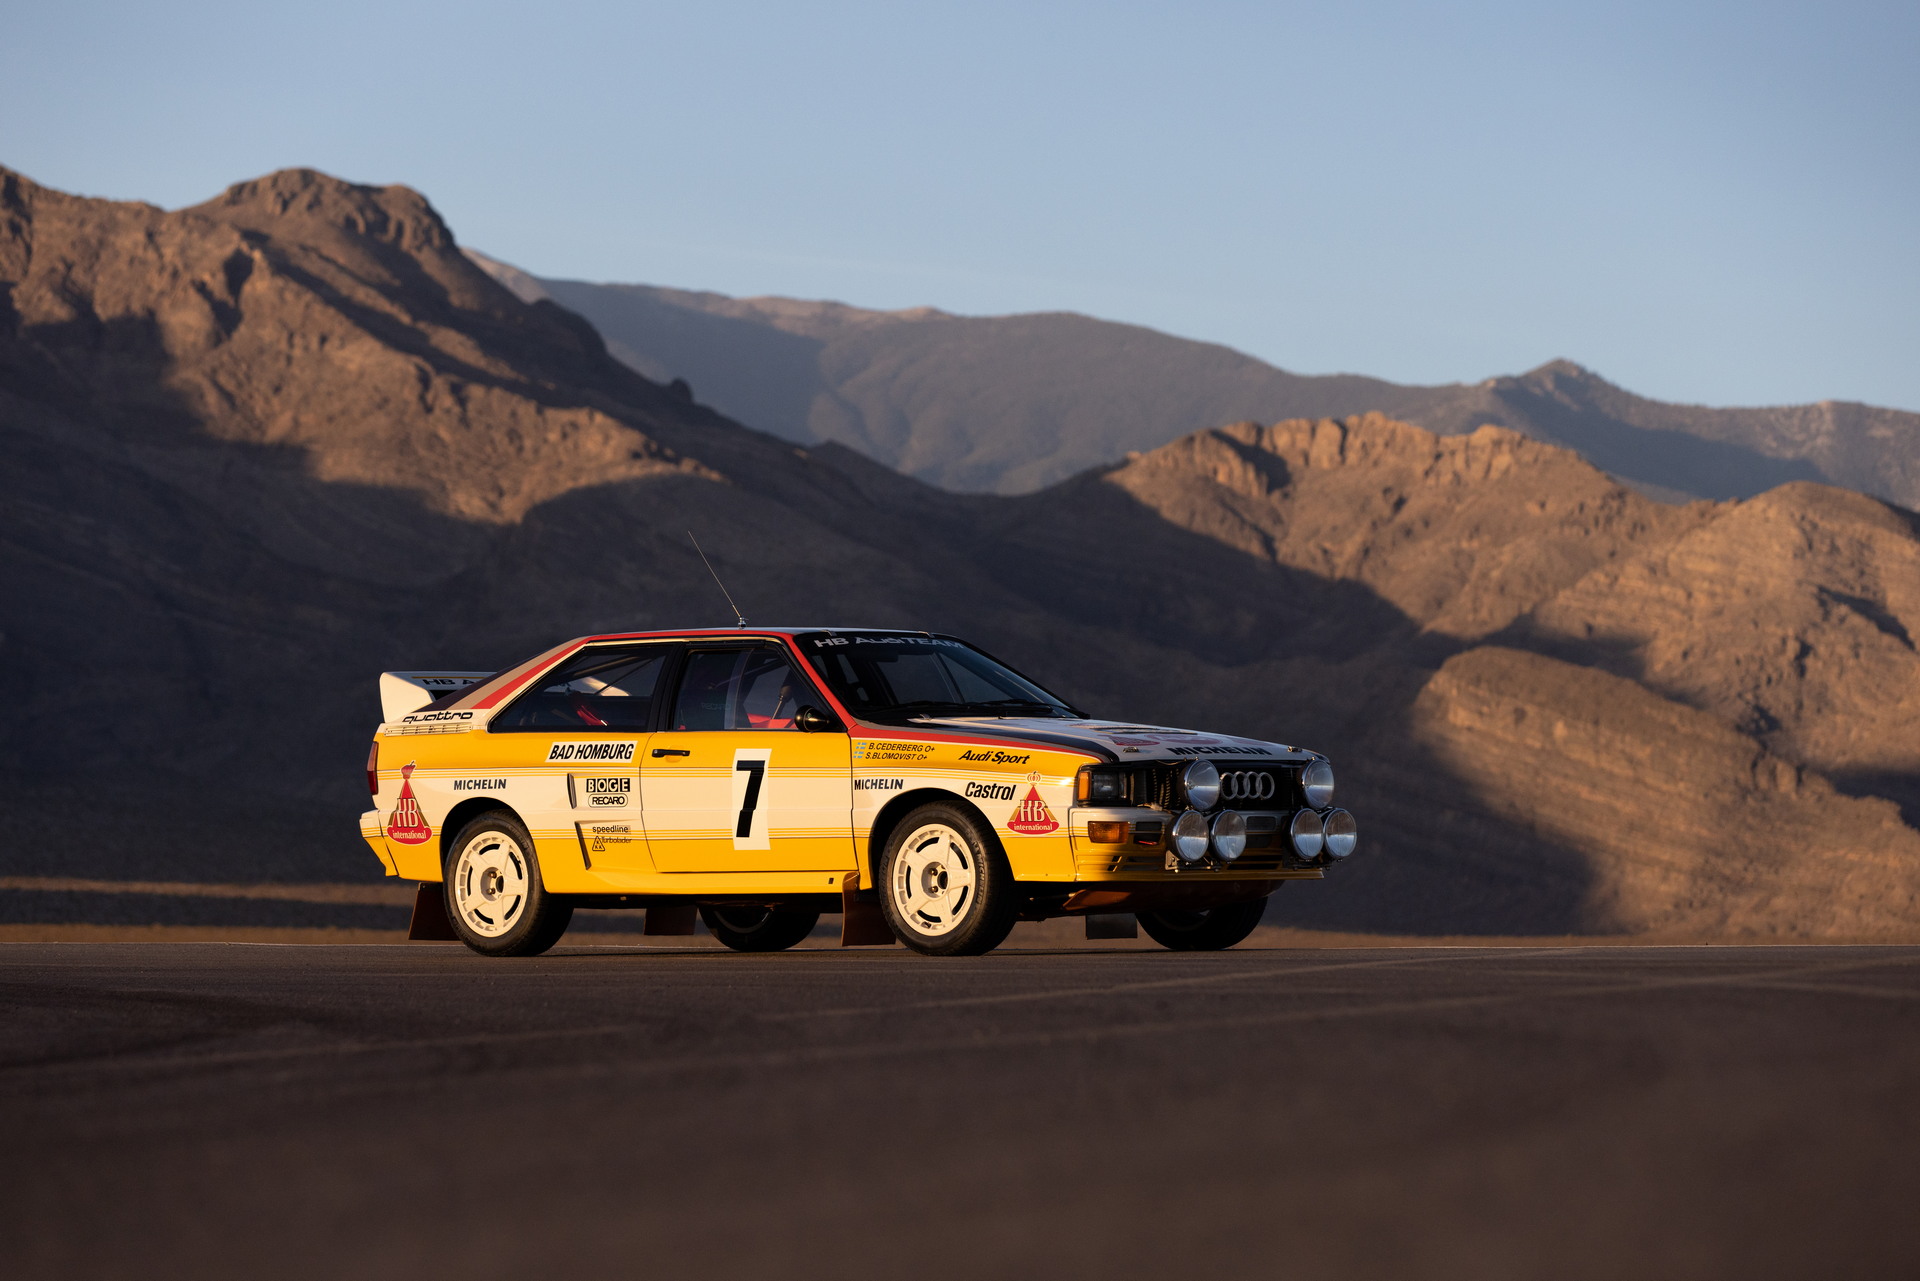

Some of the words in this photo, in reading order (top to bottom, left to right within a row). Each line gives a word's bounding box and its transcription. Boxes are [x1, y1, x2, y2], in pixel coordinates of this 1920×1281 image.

[814, 637, 849, 648] HB
[402, 711, 473, 724] quattro
[549, 744, 575, 760] BAD
[574, 743, 634, 760] HOMBURG
[868, 742, 923, 752] B.CEDERBERG
[1166, 746, 1272, 756] MICHELIN
[865, 751, 917, 760] S.BLOMQVIST
[959, 750, 993, 762] Audi
[991, 751, 1030, 764] Sport
[454, 779, 507, 790] MICHELIN
[587, 778, 630, 792] BOGE
[854, 779, 904, 790] MICHELIN
[965, 781, 1017, 800] Castrol
[592, 796, 625, 805] RECARO
[736, 760, 766, 838] 7
[396, 798, 419, 828] HB
[1020, 800, 1046, 822] HB
[392, 830, 427, 839] international
[592, 825, 629, 834] speedline
